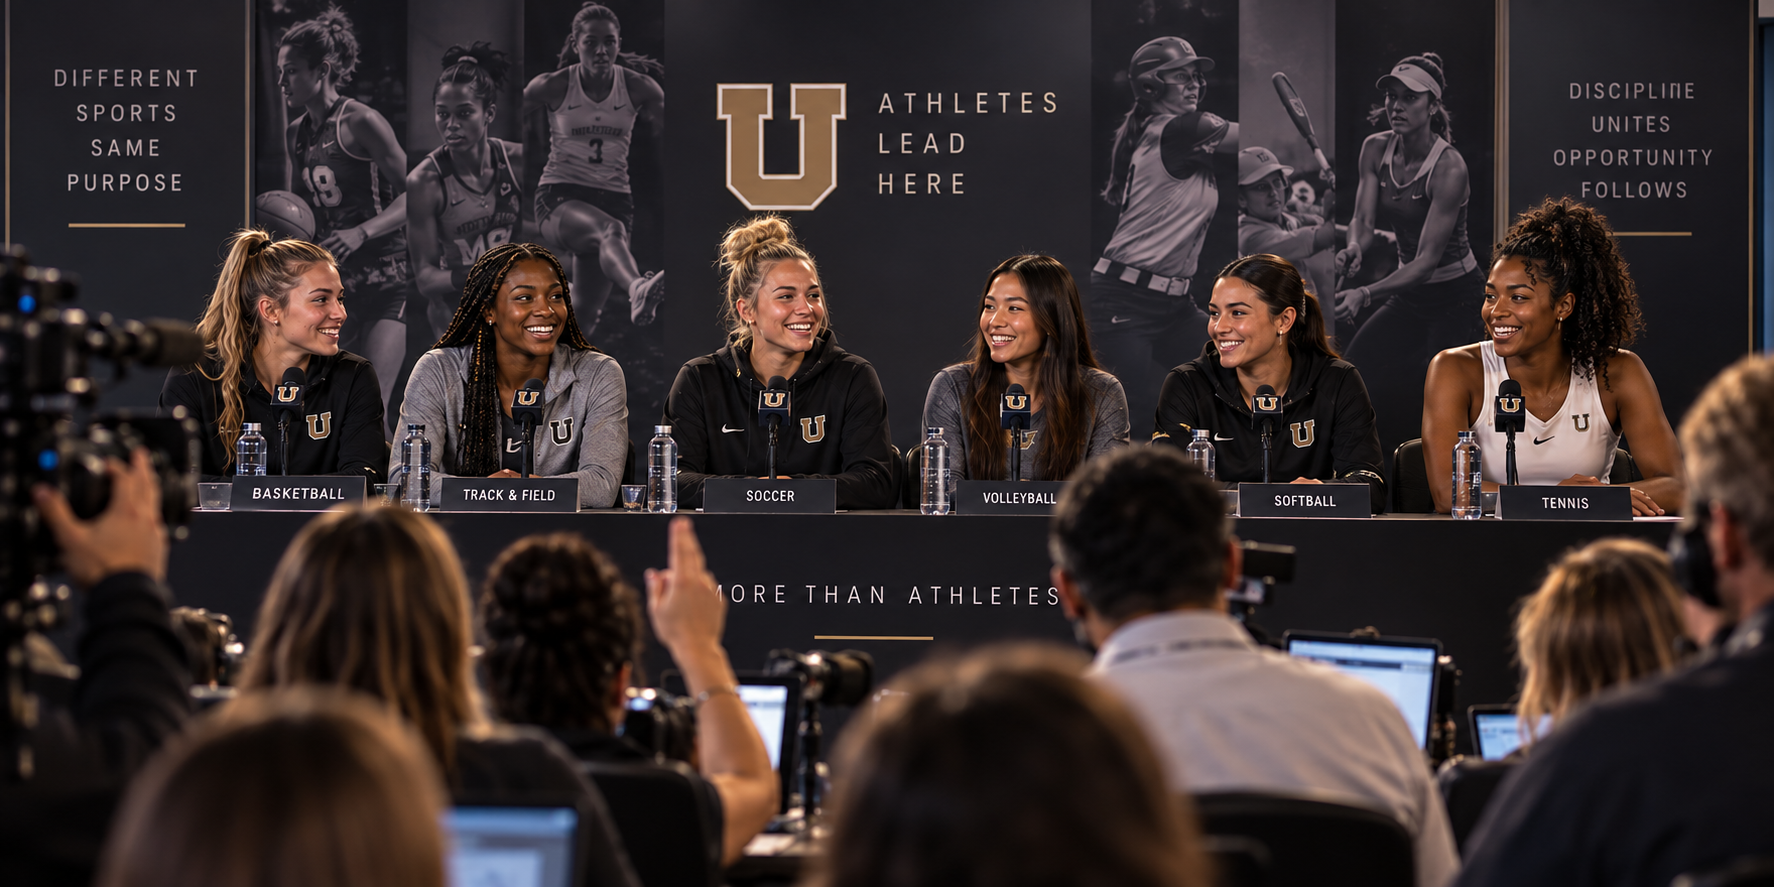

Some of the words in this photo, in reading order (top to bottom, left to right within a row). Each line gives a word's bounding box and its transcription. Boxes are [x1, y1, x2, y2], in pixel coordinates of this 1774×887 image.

[54, 69, 198, 88] DIFFERENT
[878, 91, 1057, 114] ATHLETES
[76, 103, 177, 122] SPORTS
[1592, 115, 1670, 133] UNITES
[91, 138, 160, 157] SAME
[588, 138, 603, 164] 3
[717, 83, 847, 211] U
[879, 132, 965, 154] LEAD
[1553, 149, 1713, 166] OPPORTUNITY
[67, 173, 182, 192] PURPOSE
[878, 173, 964, 195] HERE
[1581, 181, 1687, 199] FOLLOWS
[277, 386, 299, 402] U
[518, 391, 539, 405] U
[763, 392, 786, 407] U
[1005, 395, 1027, 410] U
[1256, 397, 1278, 411] U
[1499, 398, 1521, 413] U
[306, 411, 331, 440] U
[549, 416, 574, 446] U
[800, 414, 826, 444] U
[1571, 413, 1590, 432] U
[1289, 418, 1315, 448] U
[252, 487, 345, 501] BASKETBALL
[463, 488, 504, 501] TRACK
[508, 489, 518, 501] &
[521, 489, 556, 501] FIELD
[746, 489, 796, 502] SOCCER
[982, 492, 1057, 504] VOLLEYBALL
[1274, 494, 1337, 507] SOFTBALL
[1541, 497, 1590, 510] TENNIS
[805, 584, 884, 604] THAN
[908, 585, 1060, 606] ATHLETES
